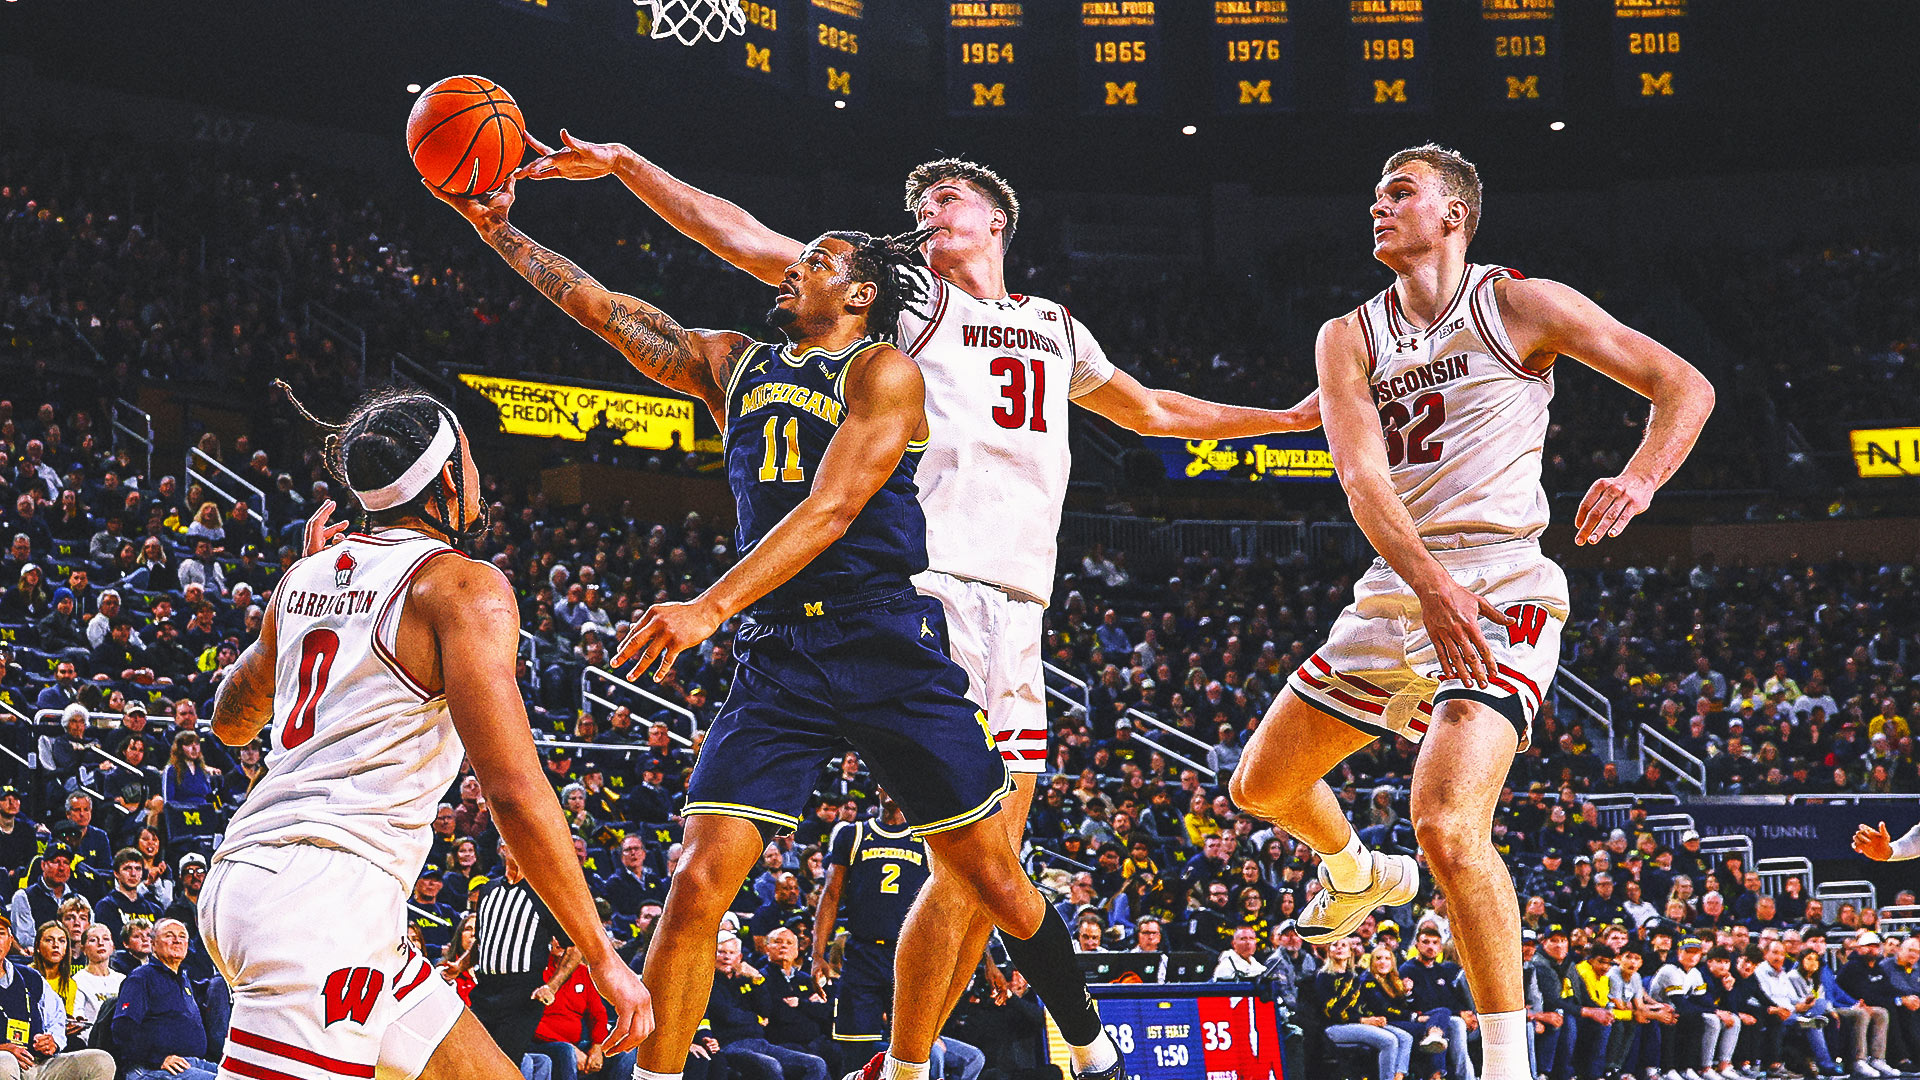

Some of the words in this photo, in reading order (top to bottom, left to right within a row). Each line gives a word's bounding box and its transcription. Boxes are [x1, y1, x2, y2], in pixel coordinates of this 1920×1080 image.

[818, 23, 858, 54] 2025
[1228, 40, 1280, 61] 1976
[1363, 38, 1415, 60] 1989
[1495, 35, 1546, 57] 2013
[1629, 32, 1680, 54] 2018
[746, 42, 771, 73] M
[962, 43, 1014, 63] 1964
[1095, 41, 1146, 62] 1965
[827, 67, 851, 95] M
[1239, 80, 1272, 104] M
[1374, 79, 1407, 103] M
[1506, 75, 1540, 99] M
[1641, 71, 1674, 95] M
[972, 83, 1006, 106] M
[1105, 82, 1138, 105] M
[961, 324, 1064, 360] WISCONSIN
[577, 392, 599, 409] OF
[739, 382, 843, 428] MICHIGAN
[989, 356, 1048, 433] 31
[500, 403, 561, 424] CREDIT
[758, 415, 805, 483] 11
[803, 601, 825, 617] M
[1503, 603, 1549, 650] W
[281, 627, 341, 751] 0
[183, 811, 203, 826] M
[655, 829, 673, 843] M
[1762, 825, 1819, 839] TUNNEL
[880, 863, 901, 894] 2
[320, 966, 385, 1030] W
[1203, 1022, 1232, 1051] 35
[1153, 1044, 1189, 1067] 1:50
